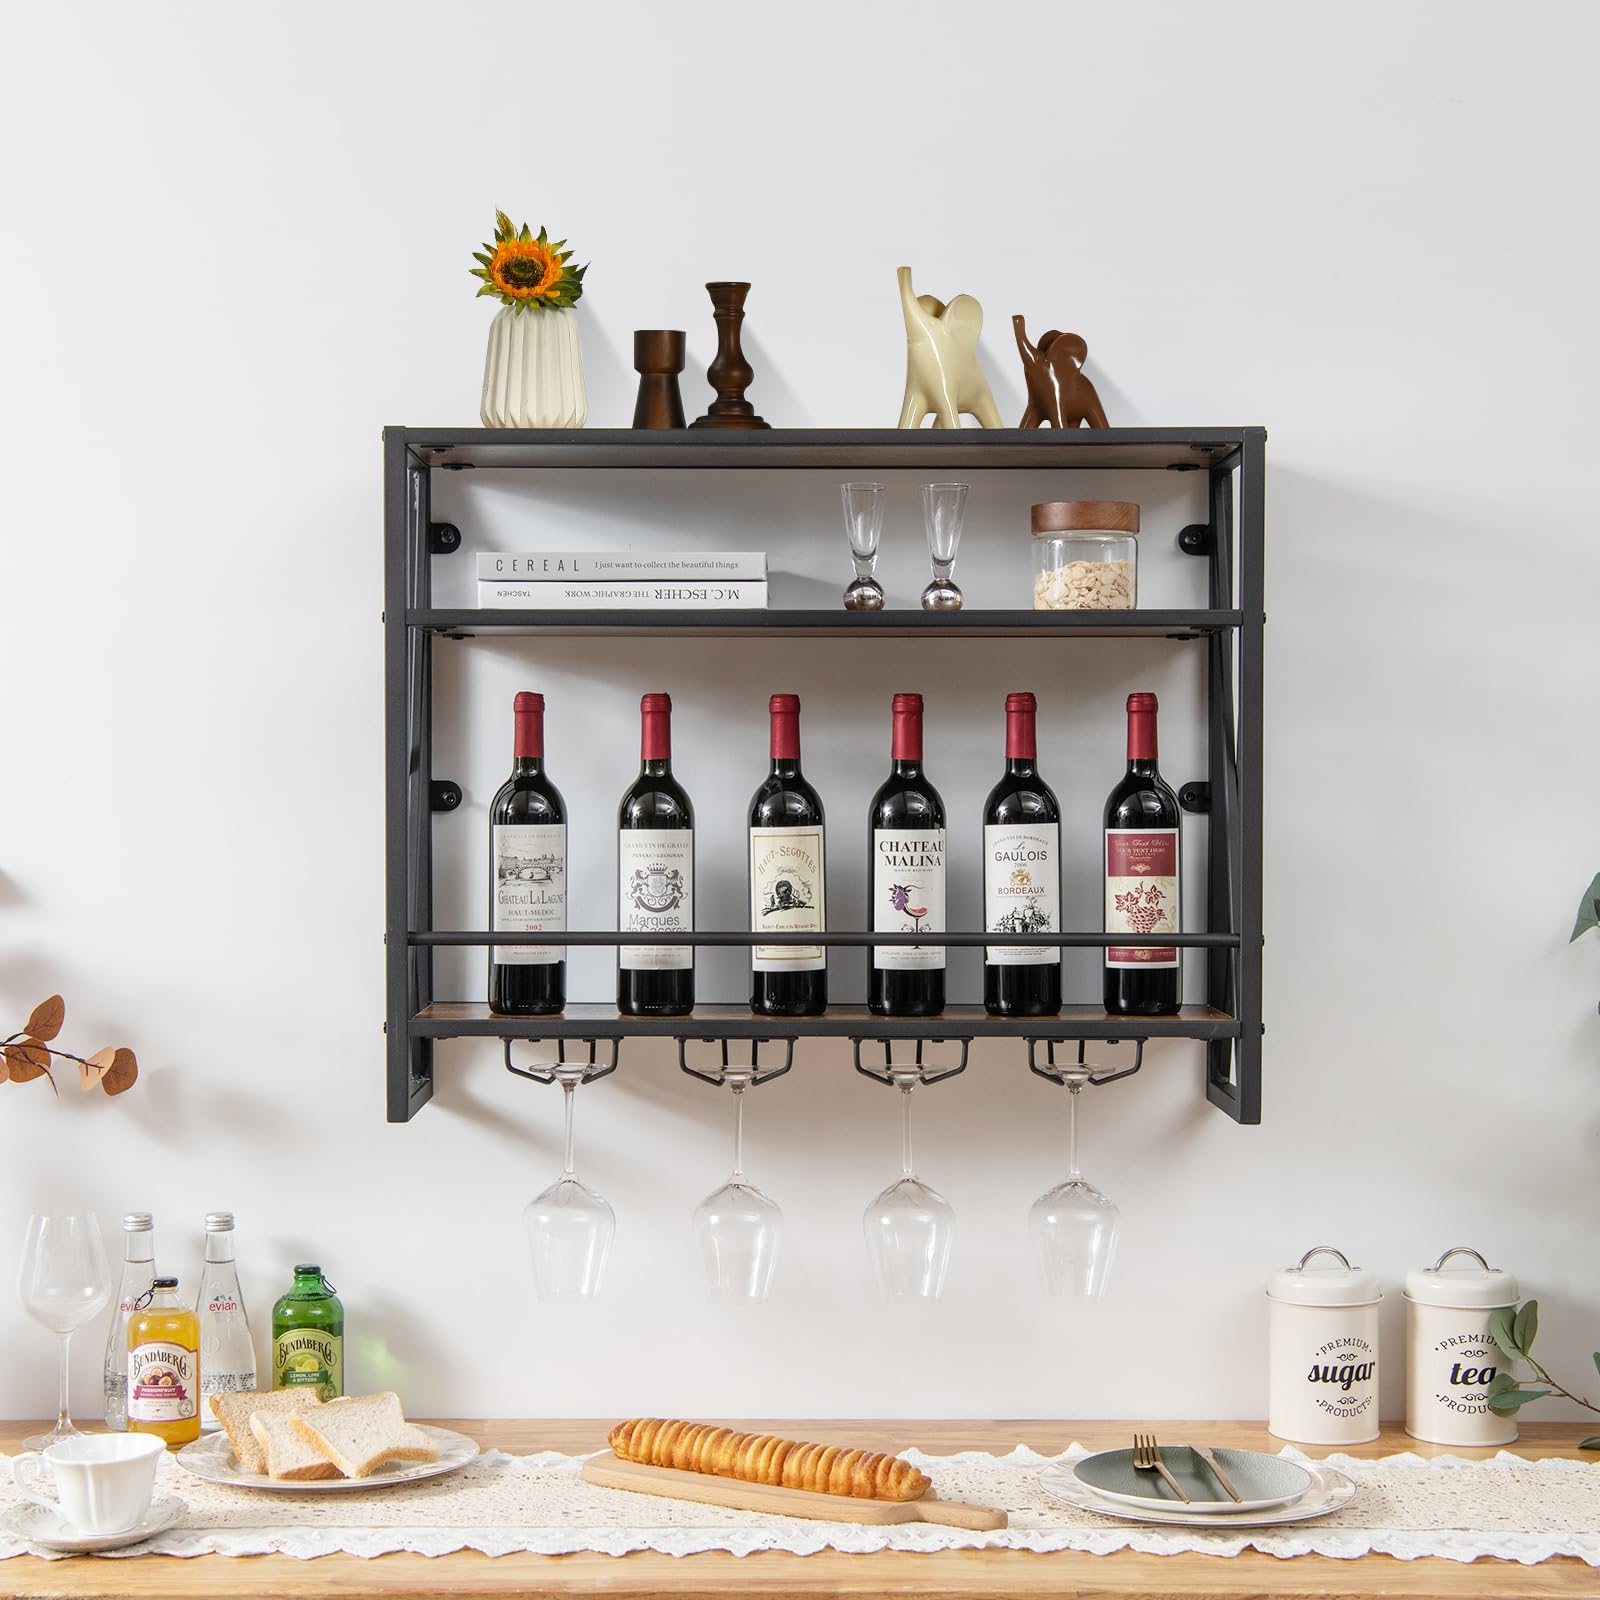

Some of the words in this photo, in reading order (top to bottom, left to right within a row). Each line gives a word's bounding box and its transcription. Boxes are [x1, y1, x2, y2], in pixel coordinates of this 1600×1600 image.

[496, 559, 581, 572] CEREAL
[599, 561, 613, 570] just
[643, 560, 667, 569] collect
[668, 560, 680, 569] the
[681, 560, 715, 569] beautiful
[716, 560, 739, 571] things
[565, 590, 591, 598] WORK
[592, 590, 632, 598] GRAPHIC
[632, 590, 650, 598] THE
[654, 588, 707, 600] ESCHER
[711, 588, 740, 600] M.C.
[880, 840, 944, 853] CHATEAU
[994, 851, 1048, 861] GAULOIS
[498, 890, 528, 905] CHATEAU
[998, 886, 1046, 896] BORDEAUX
[629, 913, 681, 928] Marques
[209, 1301, 239, 1311] evian
[1320, 1337, 1370, 1354] PREMIUM
[1440, 1334, 1500, 1350] PREMIU
[276, 1336, 338, 1369] BUNDABERG
[130, 1348, 193, 1381] BUNDABERG
[1307, 1361, 1375, 1391] sugar
[1450, 1362, 1497, 1386] tea
[1319, 1397, 1371, 1418] PRODUCTS
